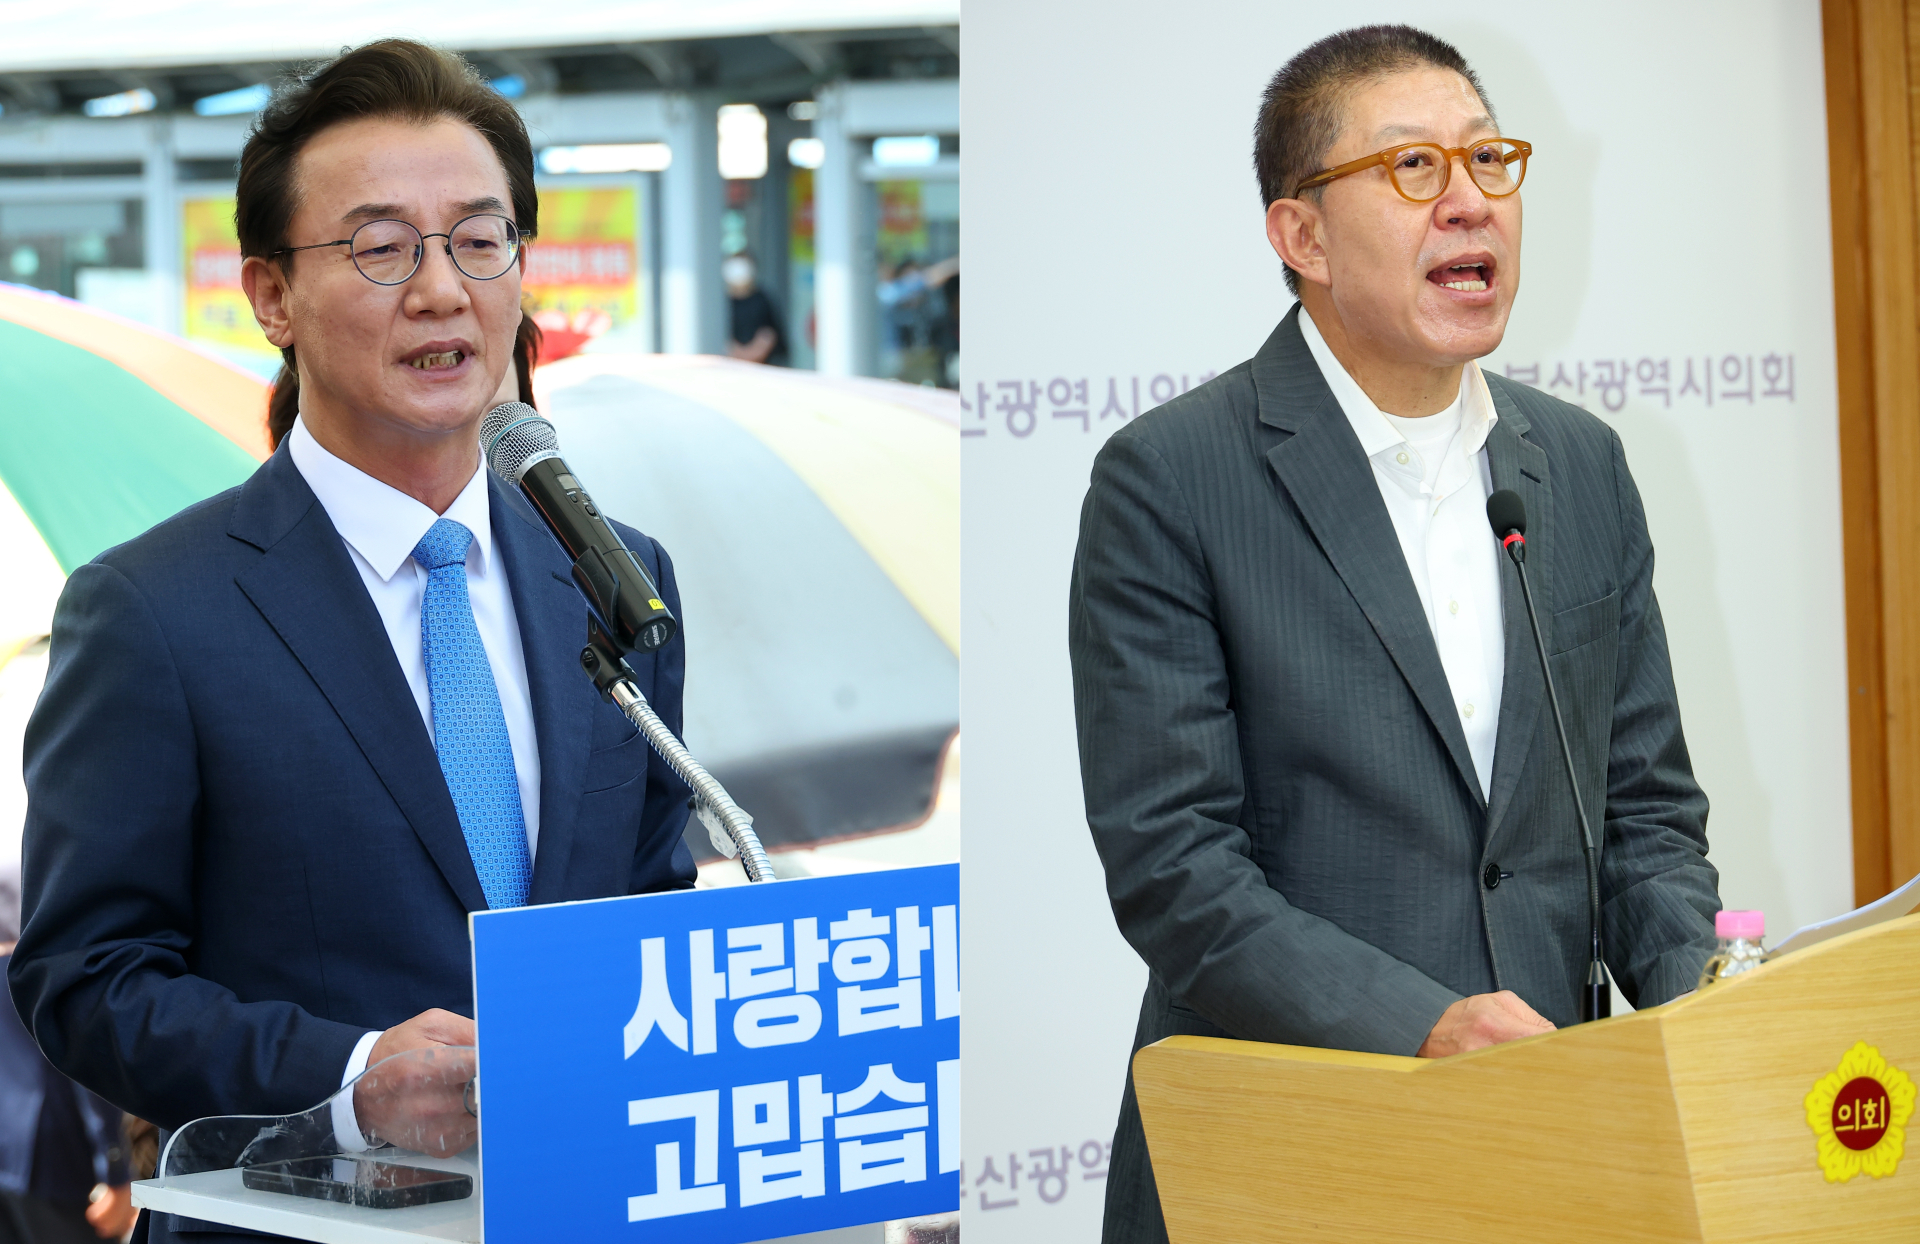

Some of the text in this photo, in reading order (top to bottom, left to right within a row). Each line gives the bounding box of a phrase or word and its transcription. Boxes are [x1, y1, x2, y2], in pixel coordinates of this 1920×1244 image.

[651, 624, 661, 646] SHURE
[1835, 1096, 1886, 1132] 의회
[961, 1138, 1114, 1212] 산광역
